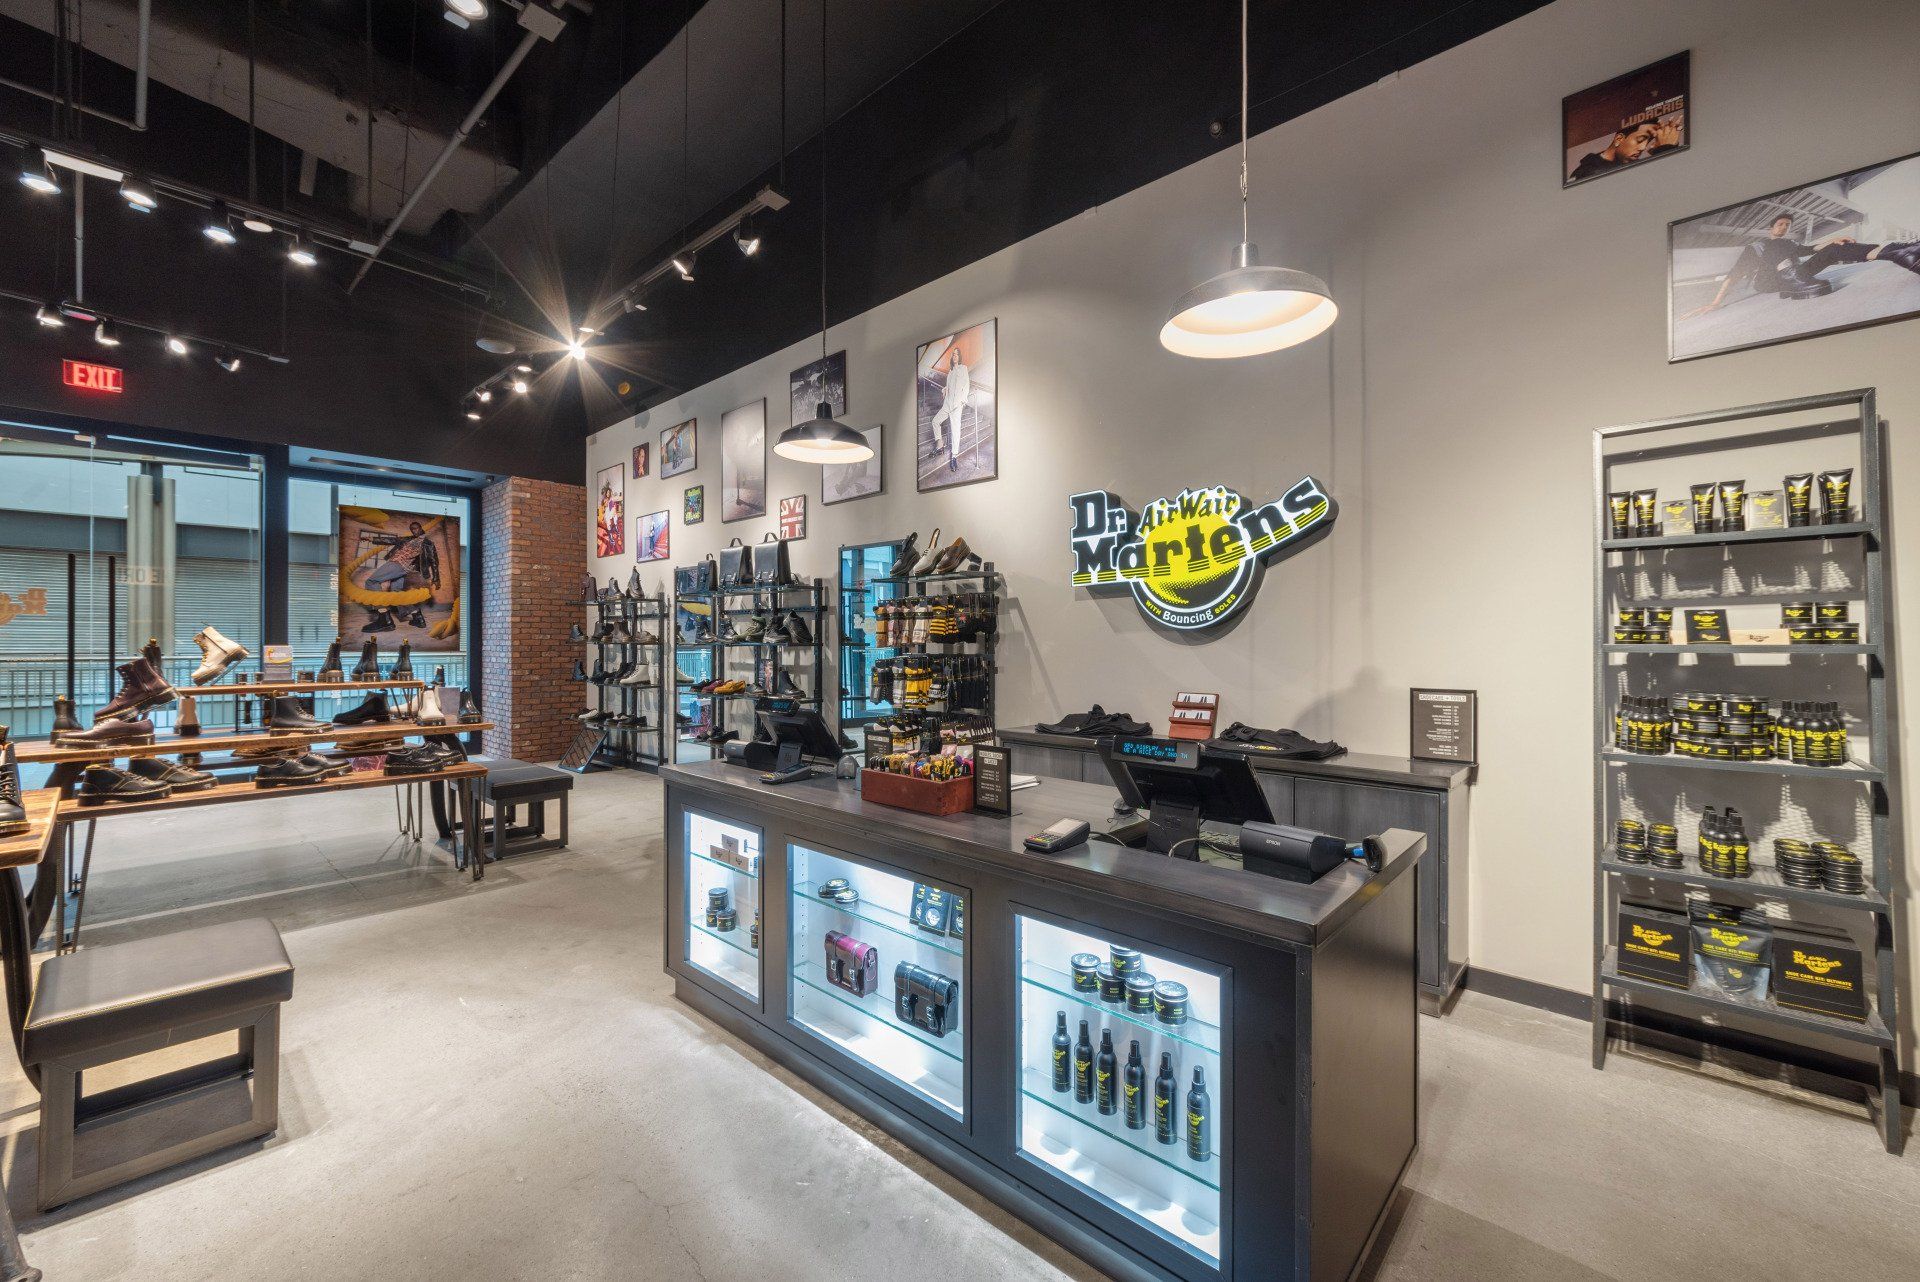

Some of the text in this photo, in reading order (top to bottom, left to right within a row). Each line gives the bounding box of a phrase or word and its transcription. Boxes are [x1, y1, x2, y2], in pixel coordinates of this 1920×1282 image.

[1621, 98, 1684, 128] LUDACRIS
[73, 363, 117, 391] EXIT
[1071, 491, 1126, 538] Dr.
[1138, 486, 1241, 534] AirWair
[1072, 477, 1328, 586] Martens
[1145, 594, 1237, 624] WITH Bouncing SOLES
